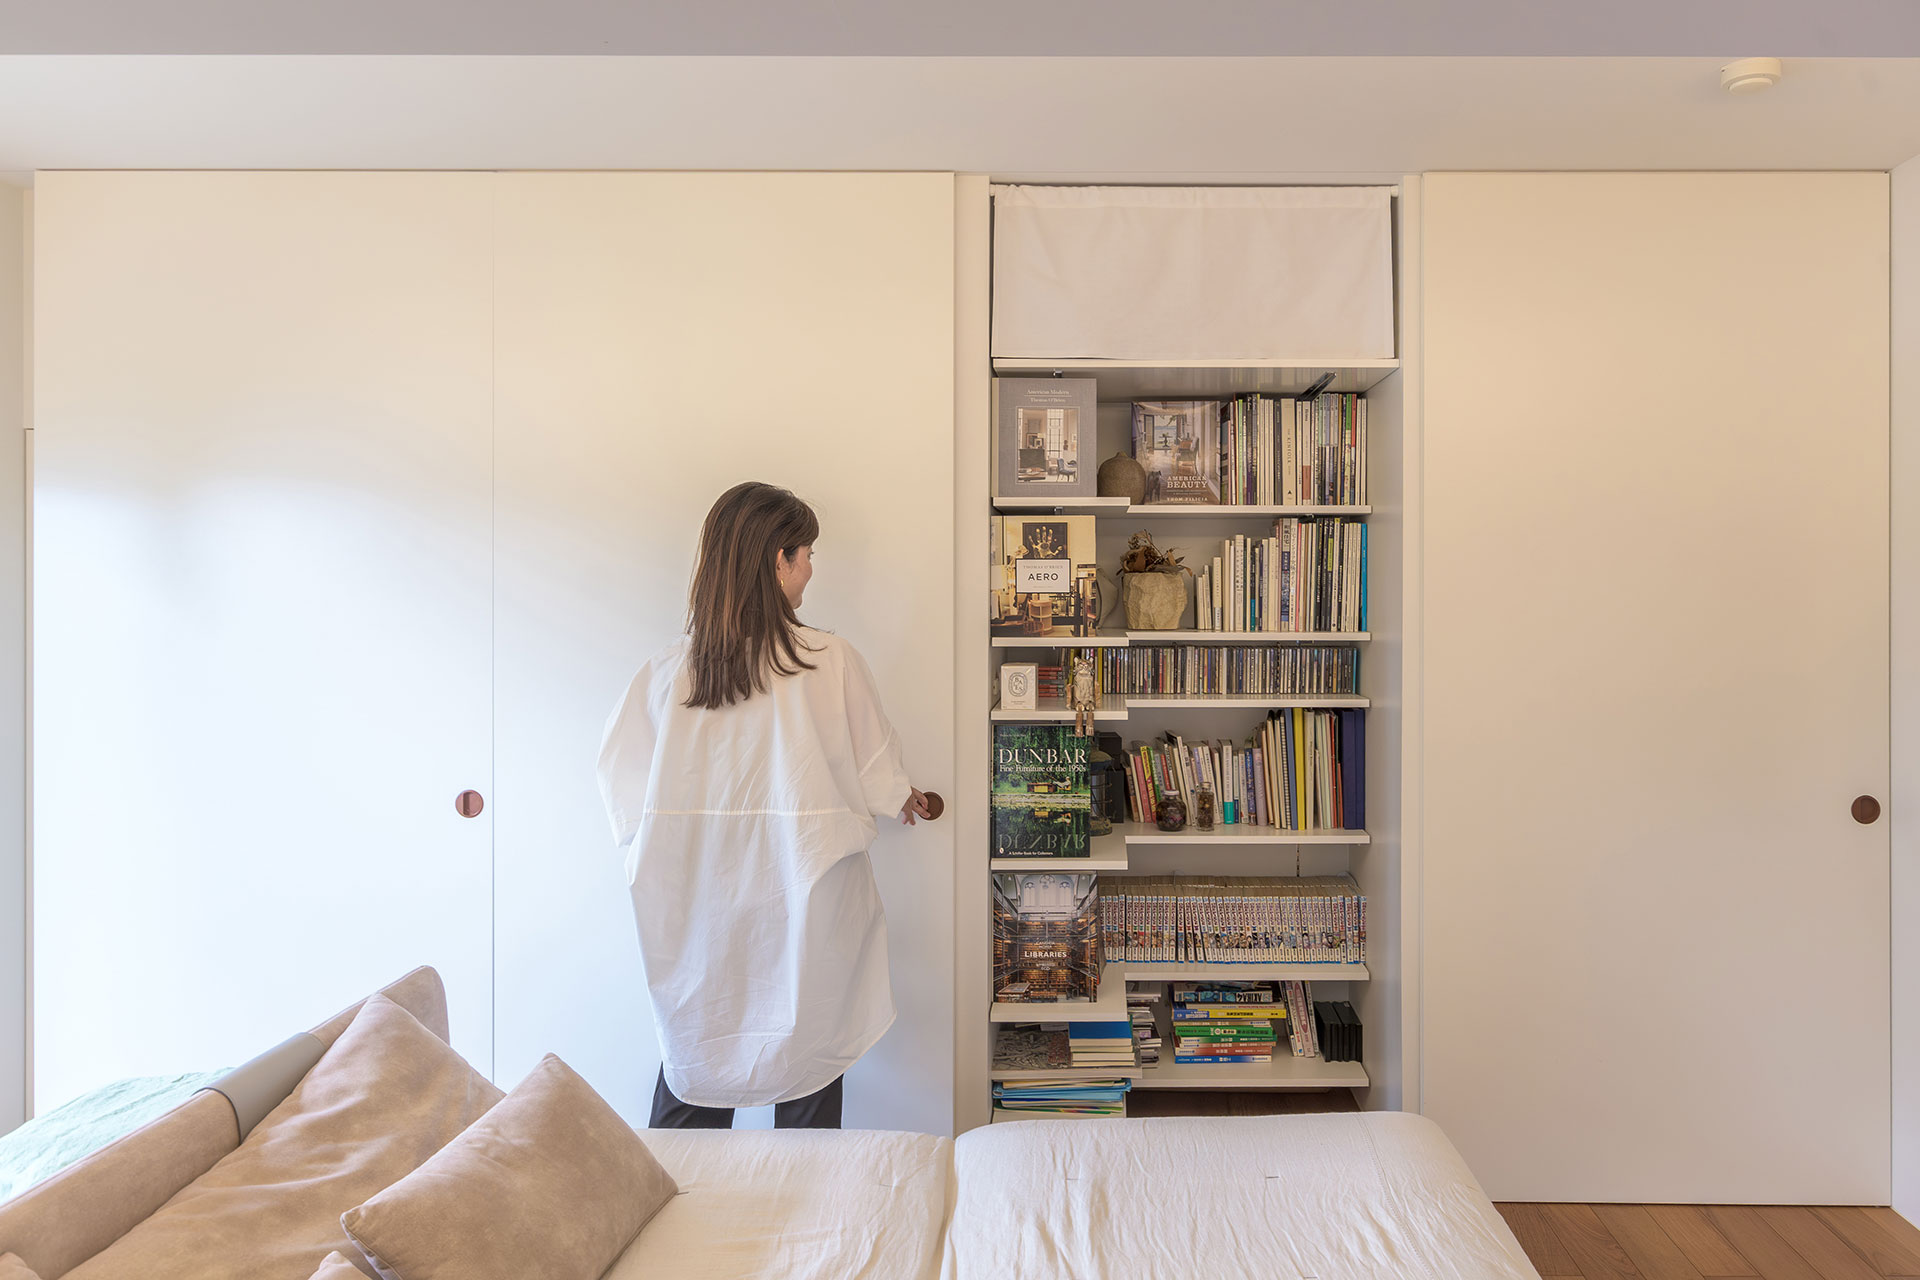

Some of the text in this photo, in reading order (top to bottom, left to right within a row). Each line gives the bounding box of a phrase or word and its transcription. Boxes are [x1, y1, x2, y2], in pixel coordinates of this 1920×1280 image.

[1028, 573, 1059, 581] AERO
[999, 748, 1087, 764] DUNBAR
[999, 764, 1014, 772] Fine
[1015, 764, 1045, 772] Furniture
[1045, 764, 1054, 772] of
[1055, 764, 1066, 772] the
